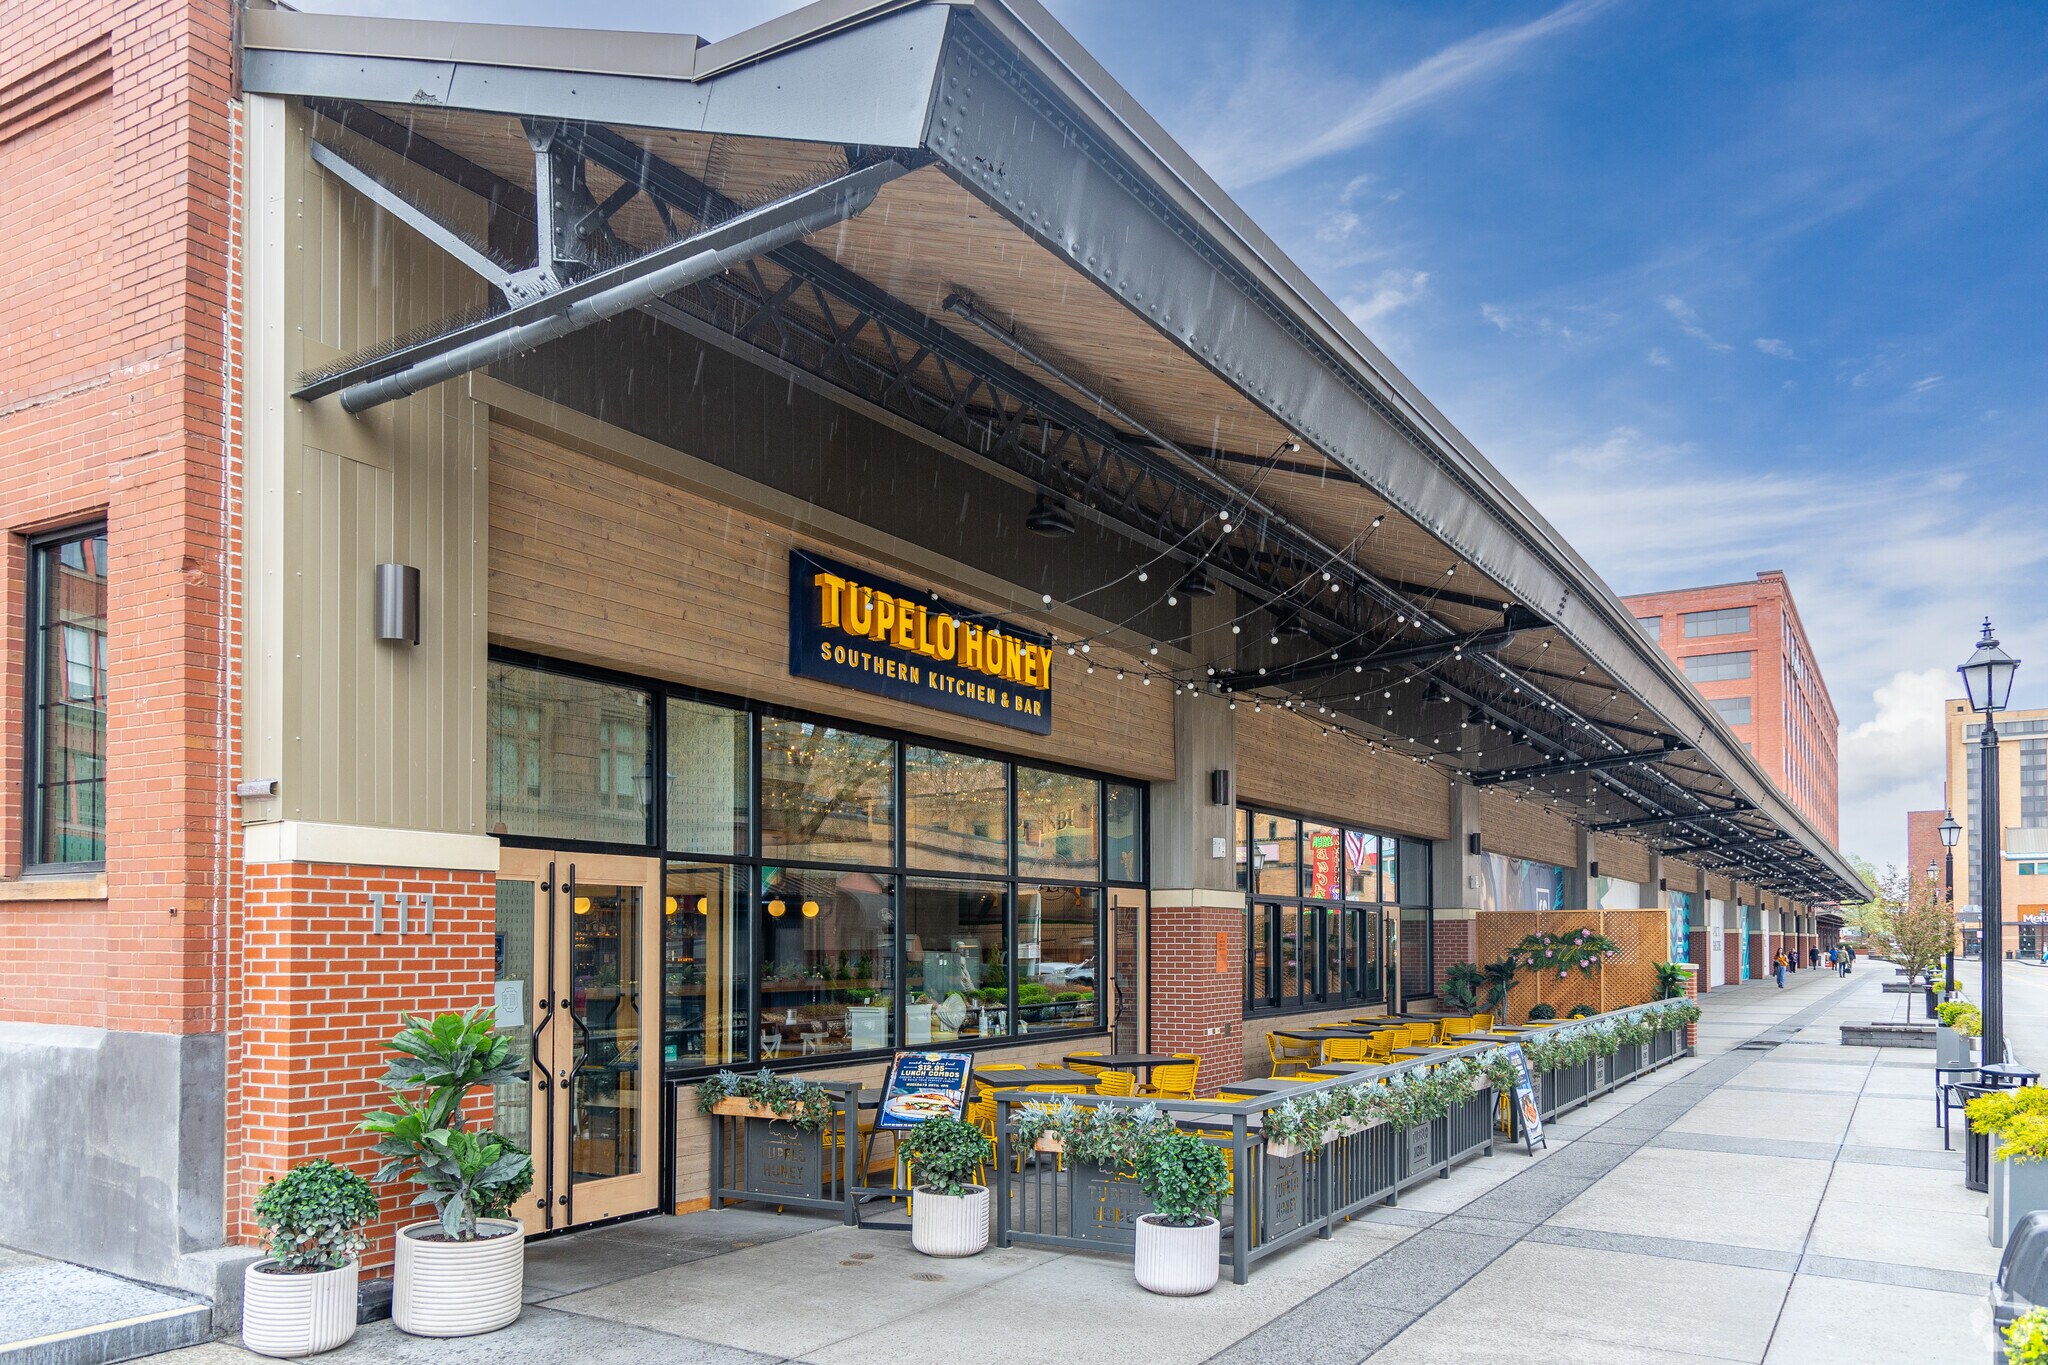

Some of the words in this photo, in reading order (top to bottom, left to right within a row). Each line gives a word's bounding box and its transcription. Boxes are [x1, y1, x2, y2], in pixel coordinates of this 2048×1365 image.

[814, 572, 956, 661] TUPELO
[957, 621, 1053, 690] HONEY
[821, 641, 920, 684] SOUTHERN
[929, 671, 996, 705] KITCHEN
[1001, 692, 1010, 708] &
[1015, 695, 1042, 717] BAR
[369, 893, 434, 935] 111
[763, 1164, 804, 1179] HONEY
